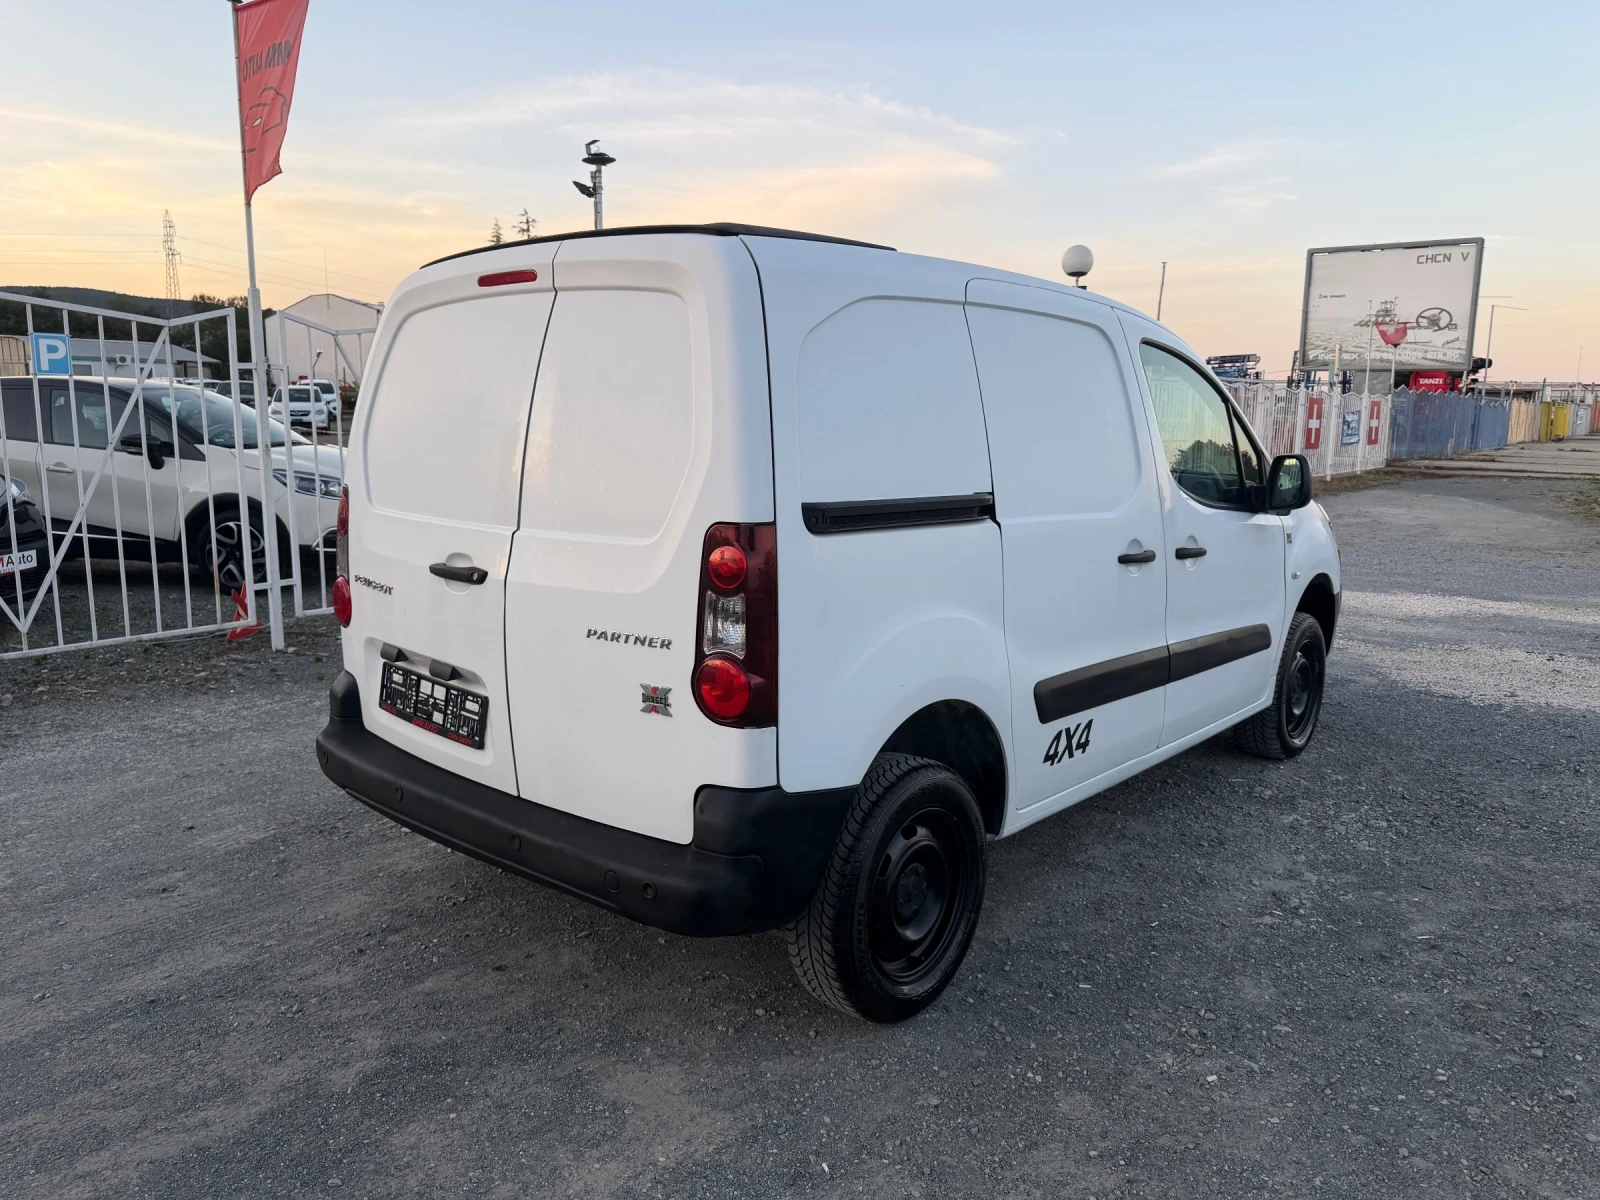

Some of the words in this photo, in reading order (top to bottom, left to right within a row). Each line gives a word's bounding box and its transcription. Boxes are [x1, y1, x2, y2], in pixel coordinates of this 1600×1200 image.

[39, 338, 67, 371] P
[354, 573, 394, 596] PEUGEOT
[586, 626, 672, 651] PARTNER
[641, 692, 671, 707] DANGEL
[1042, 718, 1094, 766] 4X4
